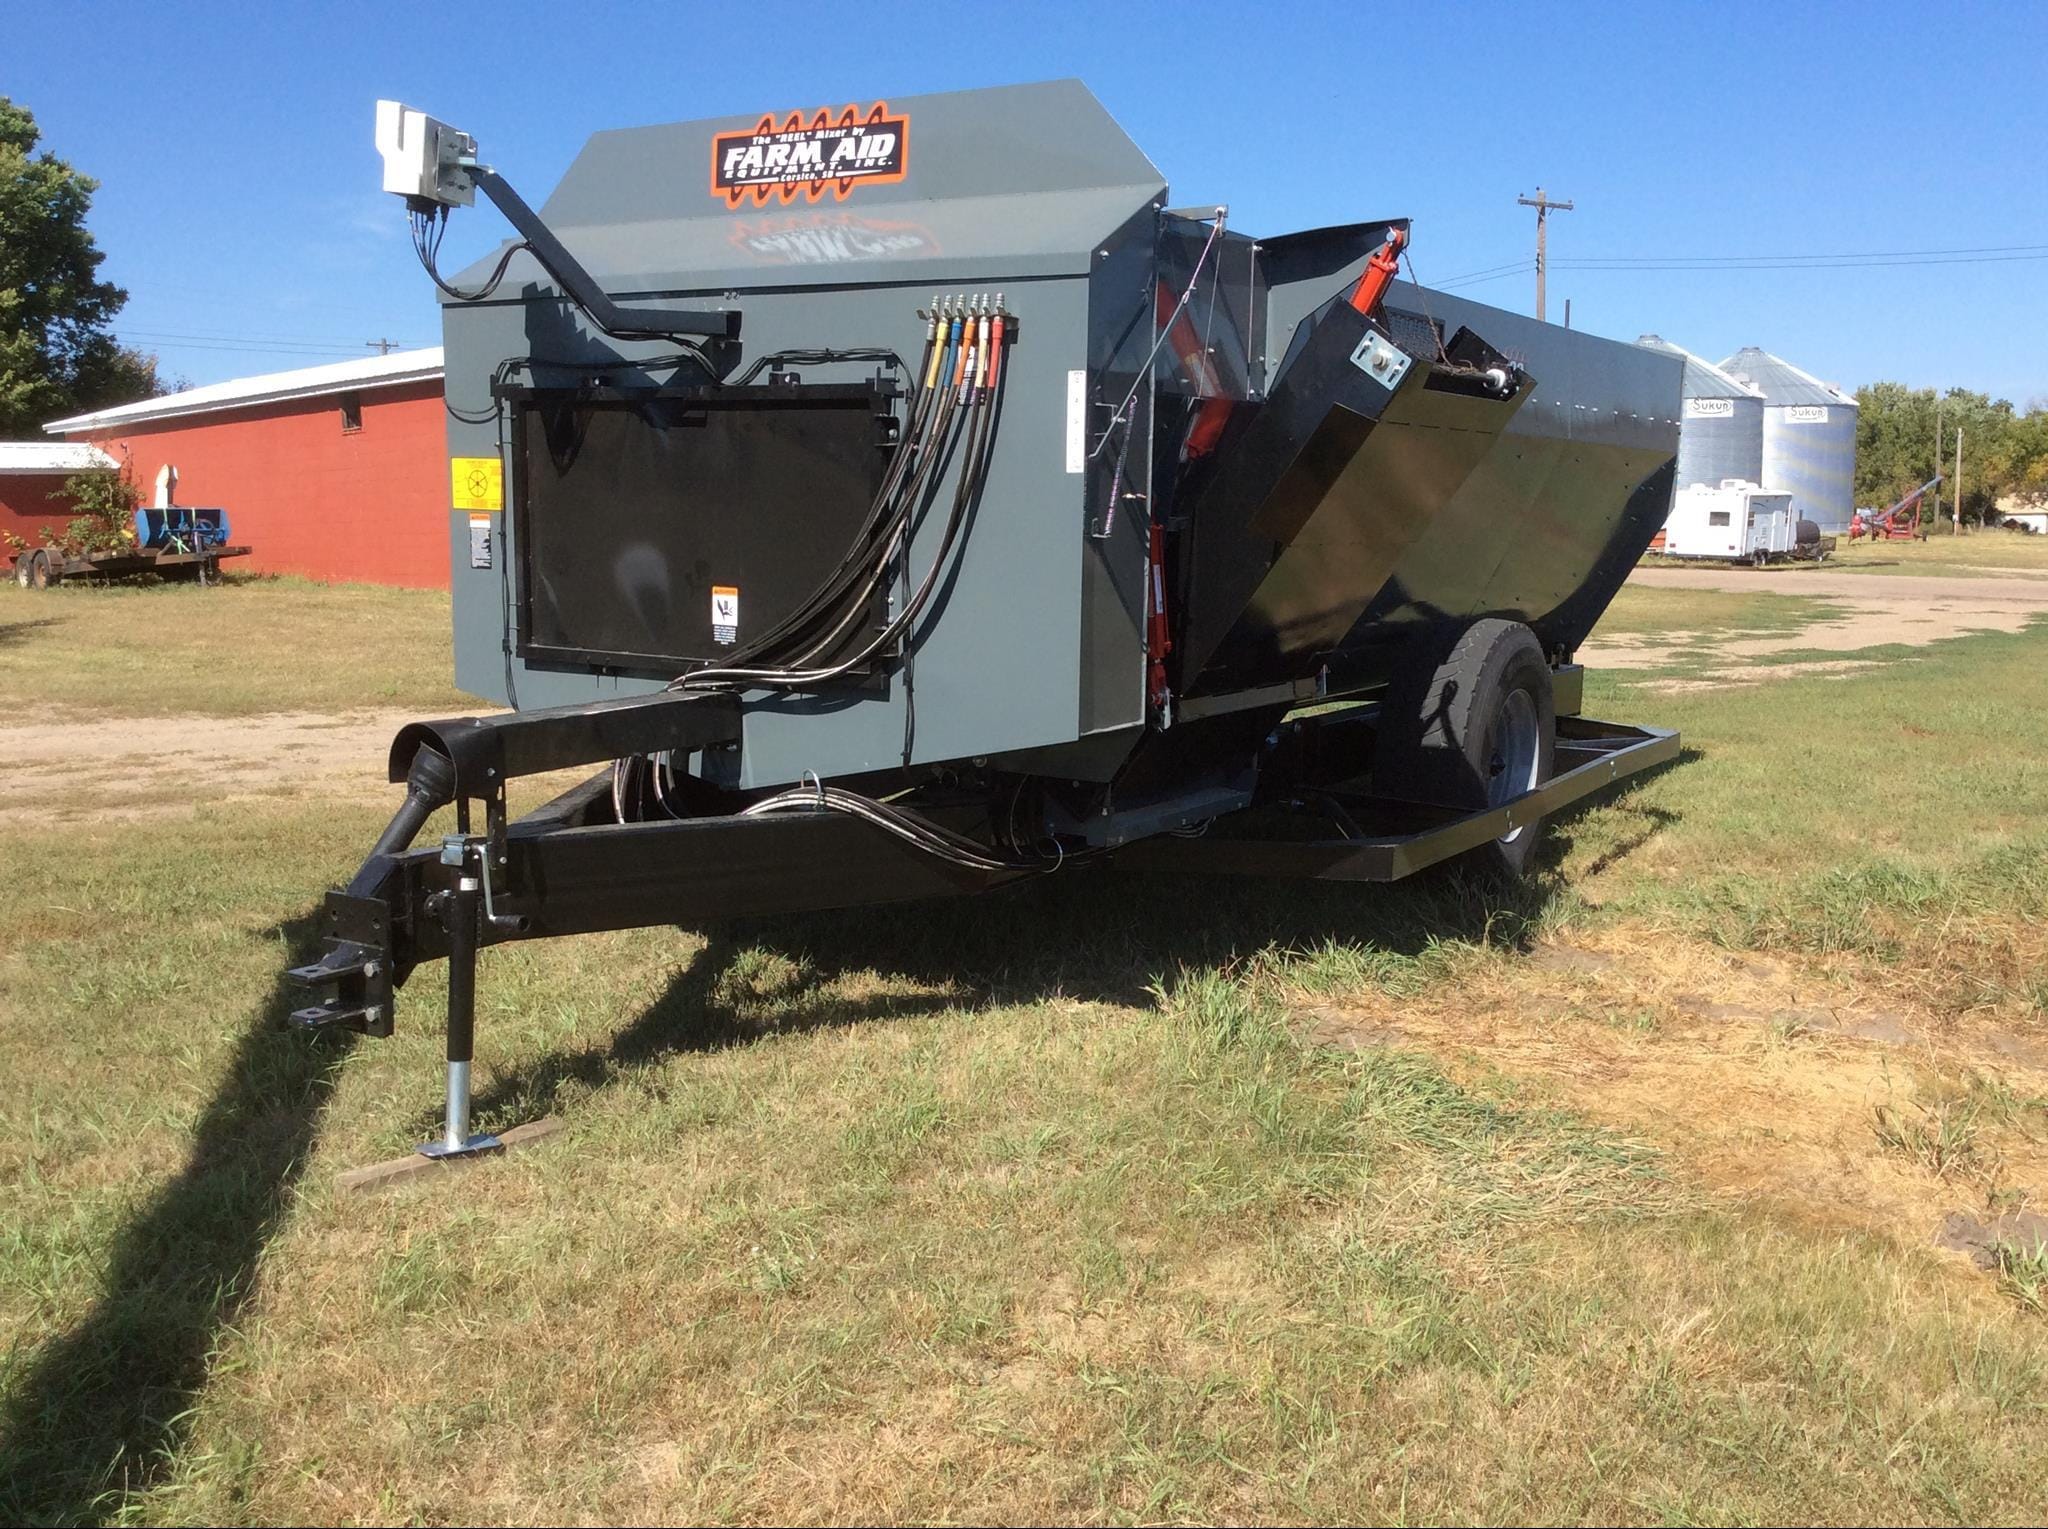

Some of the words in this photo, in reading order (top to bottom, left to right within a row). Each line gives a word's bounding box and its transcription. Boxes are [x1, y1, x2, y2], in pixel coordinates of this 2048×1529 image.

[753, 136, 771, 145] The
[816, 129, 847, 139] Mixer
[852, 127, 866, 137] by
[724, 141, 822, 171] FARM
[831, 133, 896, 161] AID
[855, 157, 893, 168] INC.
[1693, 398, 1729, 413] Sukup
[1791, 406, 1824, 420] Sukup
